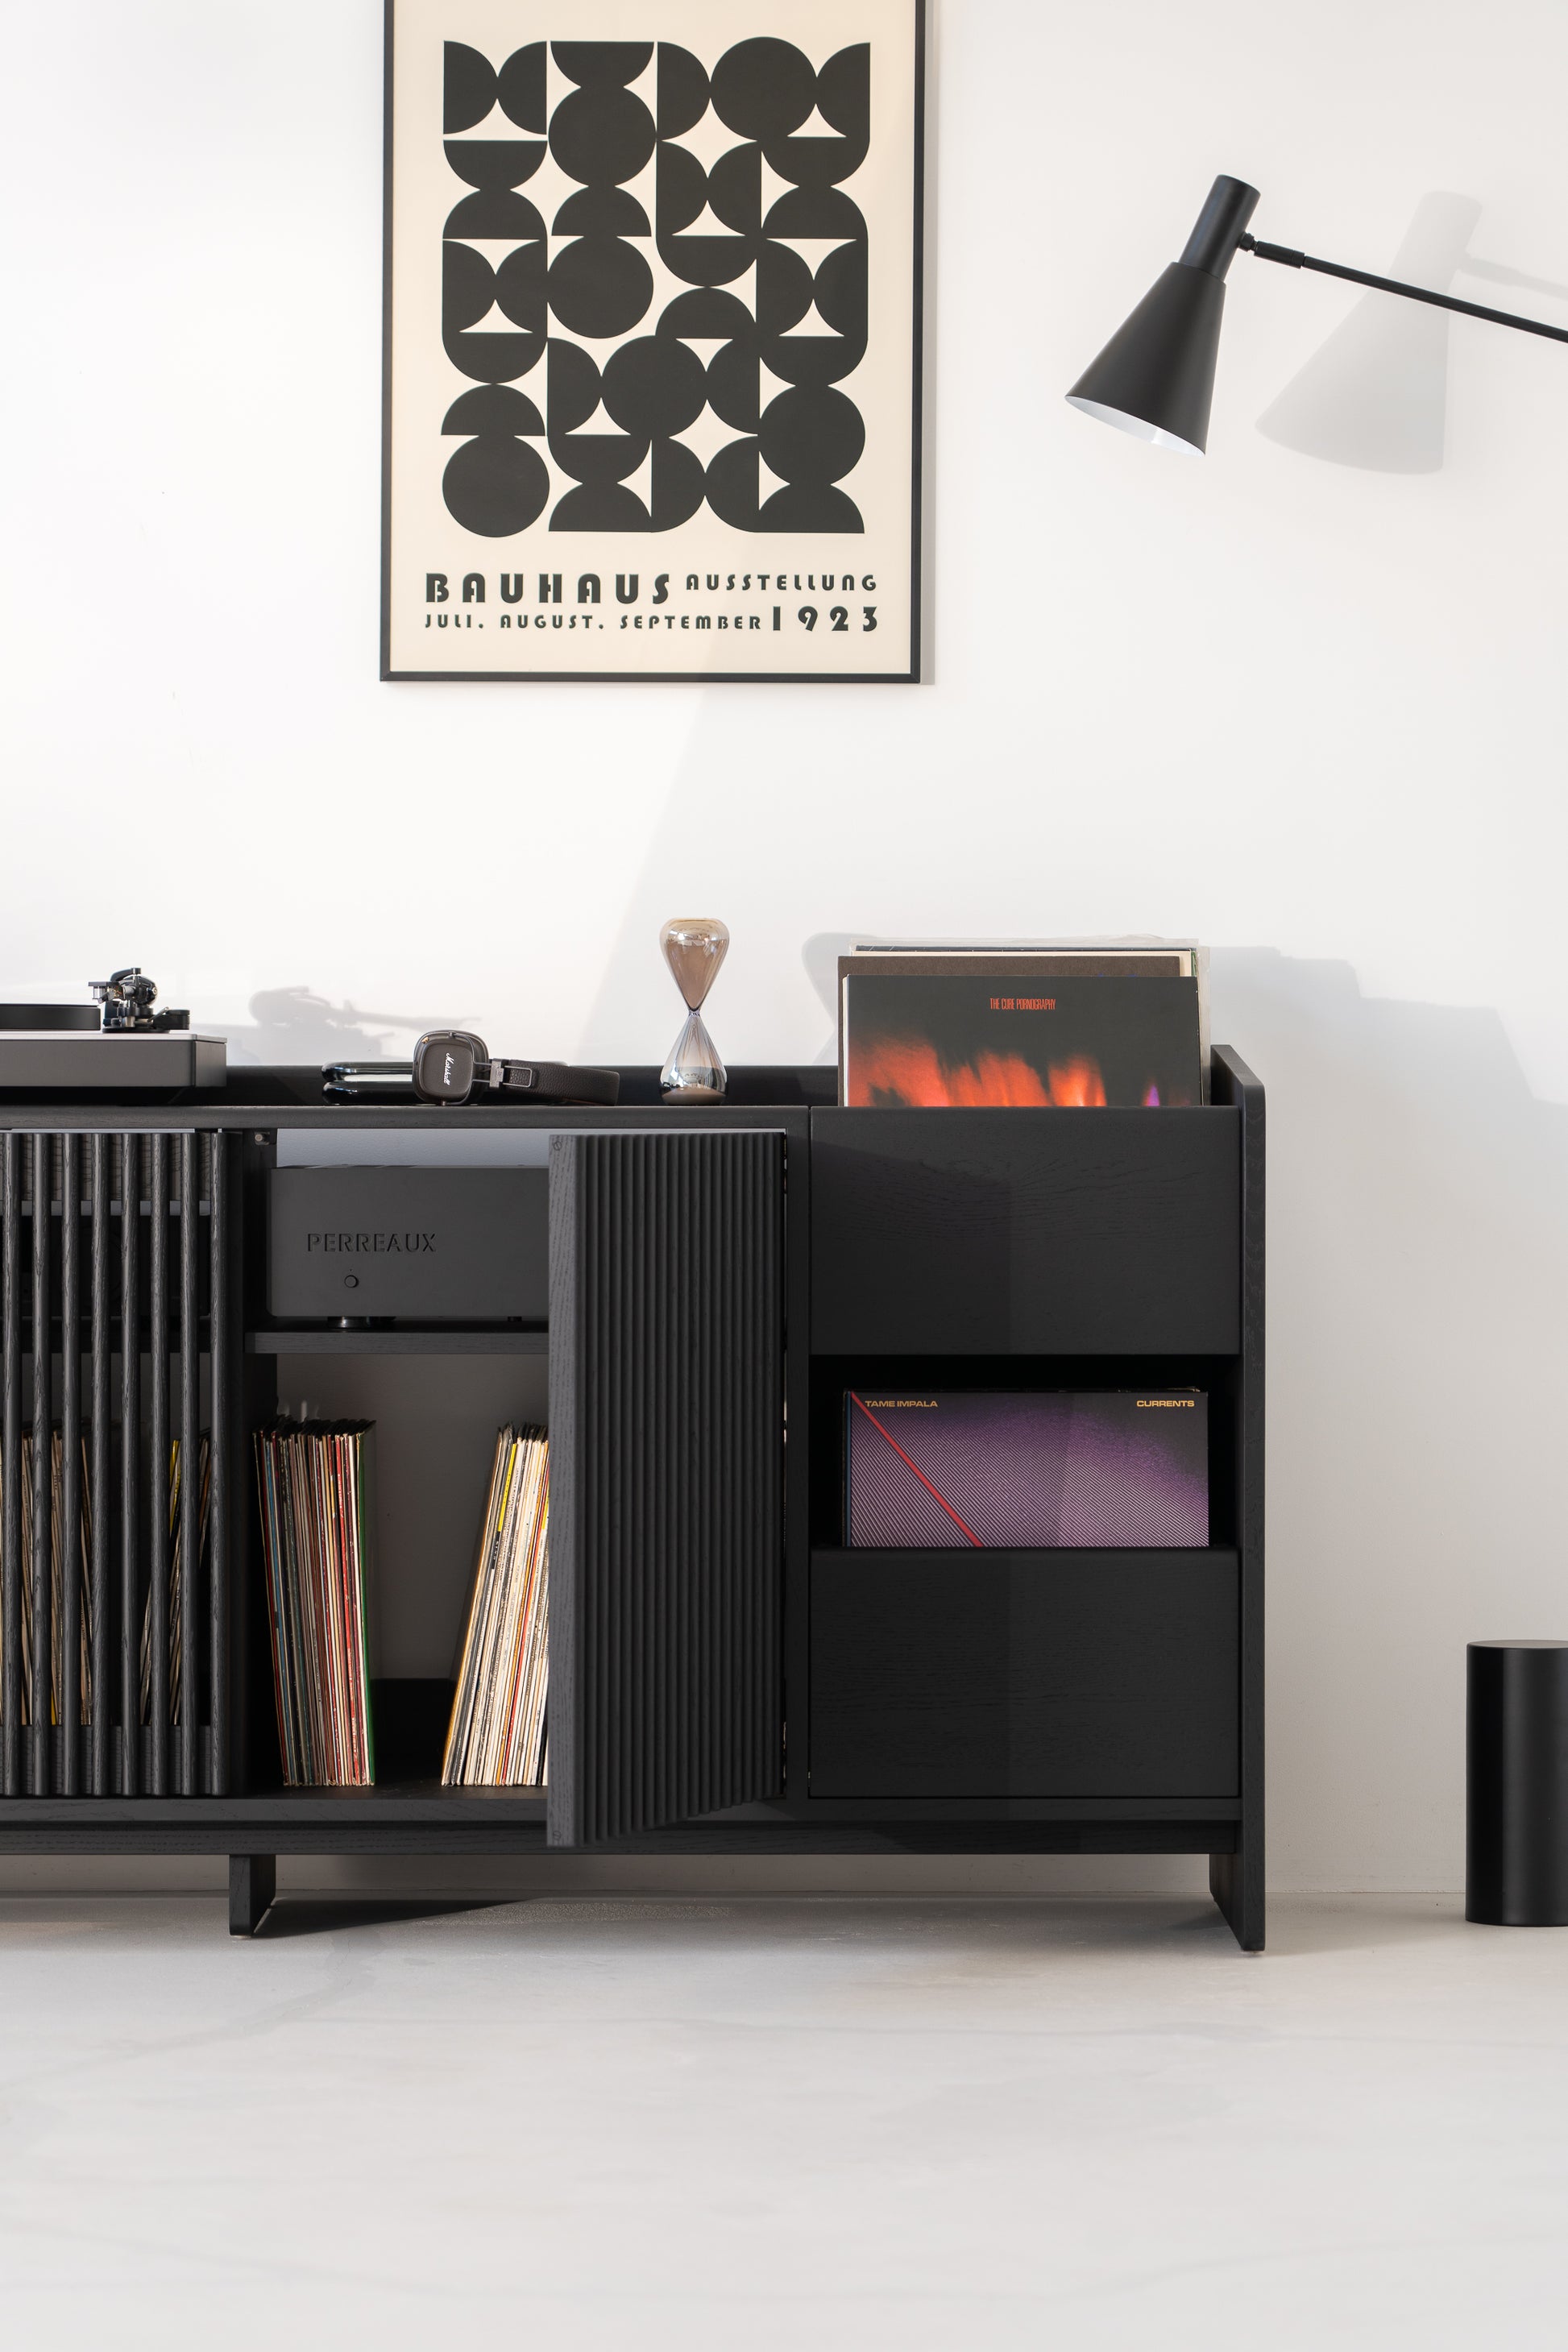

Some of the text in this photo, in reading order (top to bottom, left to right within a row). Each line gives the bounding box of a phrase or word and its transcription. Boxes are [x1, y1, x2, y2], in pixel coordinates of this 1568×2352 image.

[425, 572, 877, 604] BAUHAUS AUSSTELLUNG
[425, 605, 877, 633] JULI. AUGUST. SEPTEMBER 1923
[989, 998, 1056, 1010] THE CURE PORNOGRAPHY
[443, 1052, 454, 1086] Marshall
[307, 1233, 437, 1252] PERREAUX
[865, 1400, 938, 1408] TAME IMPALA
[1136, 1399, 1195, 1408] CURRENTS
